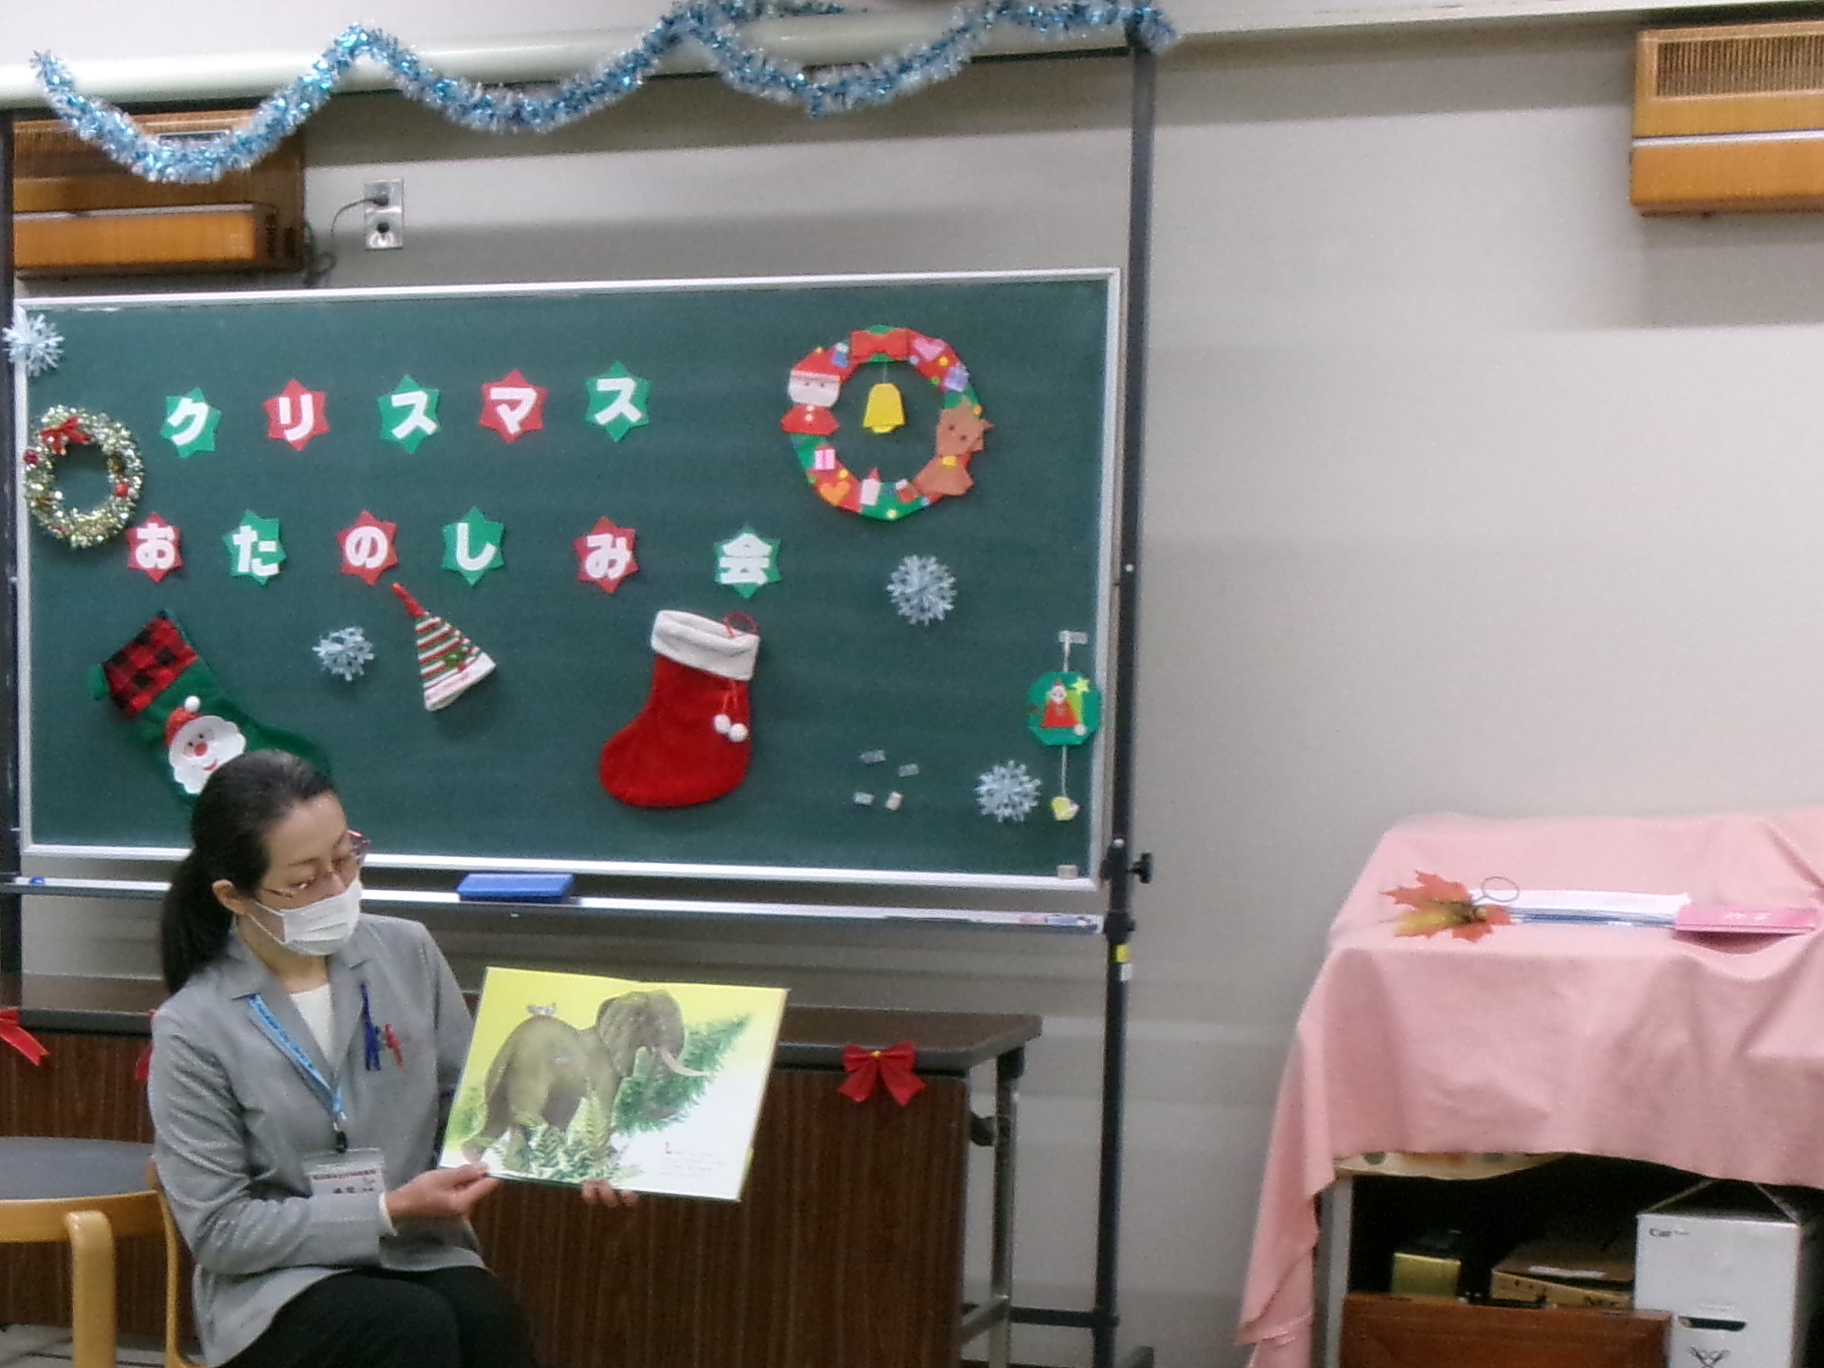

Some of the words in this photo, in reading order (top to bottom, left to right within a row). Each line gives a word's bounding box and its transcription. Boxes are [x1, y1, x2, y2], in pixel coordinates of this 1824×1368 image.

[166, 376, 643, 446] クリスマス
[133, 521, 773, 585] おたのしみ会
